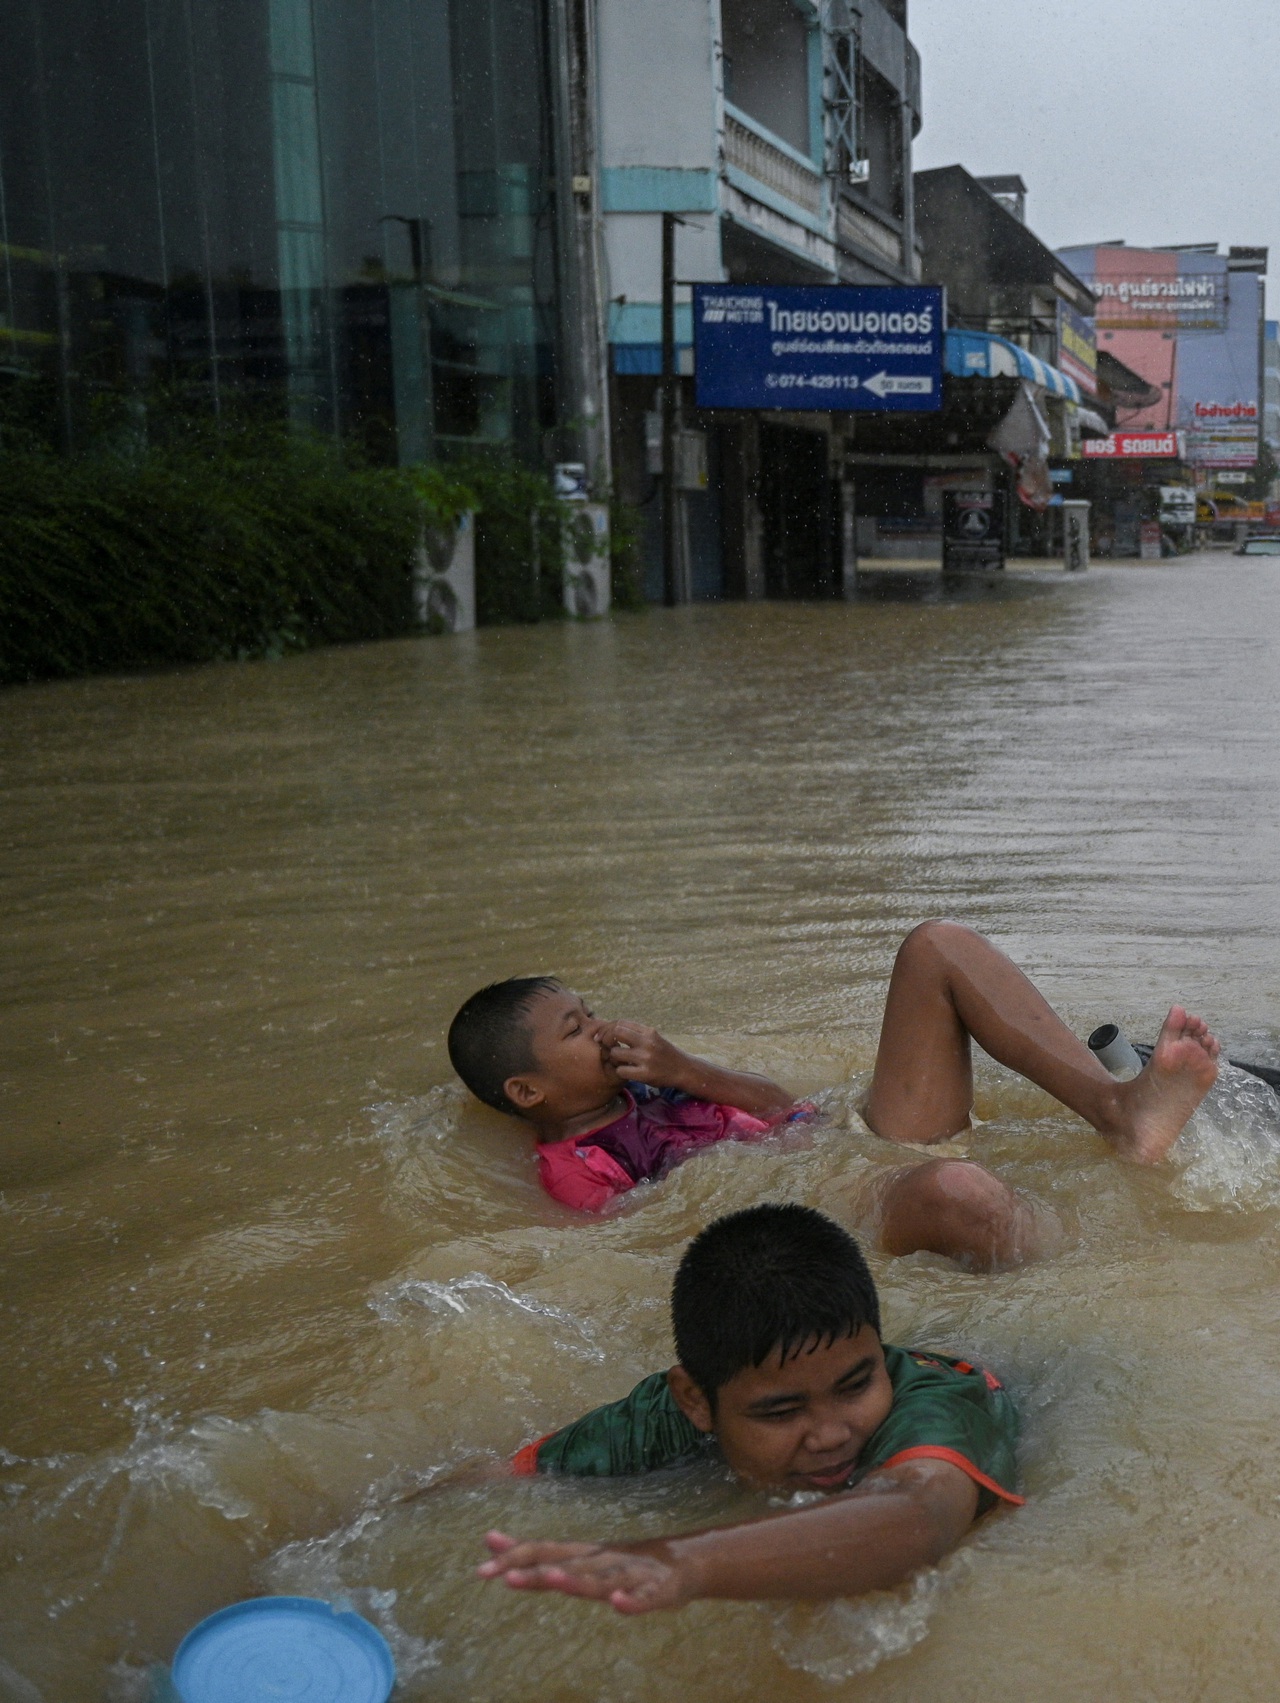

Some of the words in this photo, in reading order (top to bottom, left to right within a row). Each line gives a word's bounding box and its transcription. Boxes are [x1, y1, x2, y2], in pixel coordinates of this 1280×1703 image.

[1087, 276, 1215, 302] จก.ศูนย์รวมไฟฟ้า
[726, 310, 764, 323] MOTOR
[779, 375, 859, 389] 074-429113
[1086, 434, 1116, 454] แอร์
[1122, 434, 1174, 454] รถยนต์
